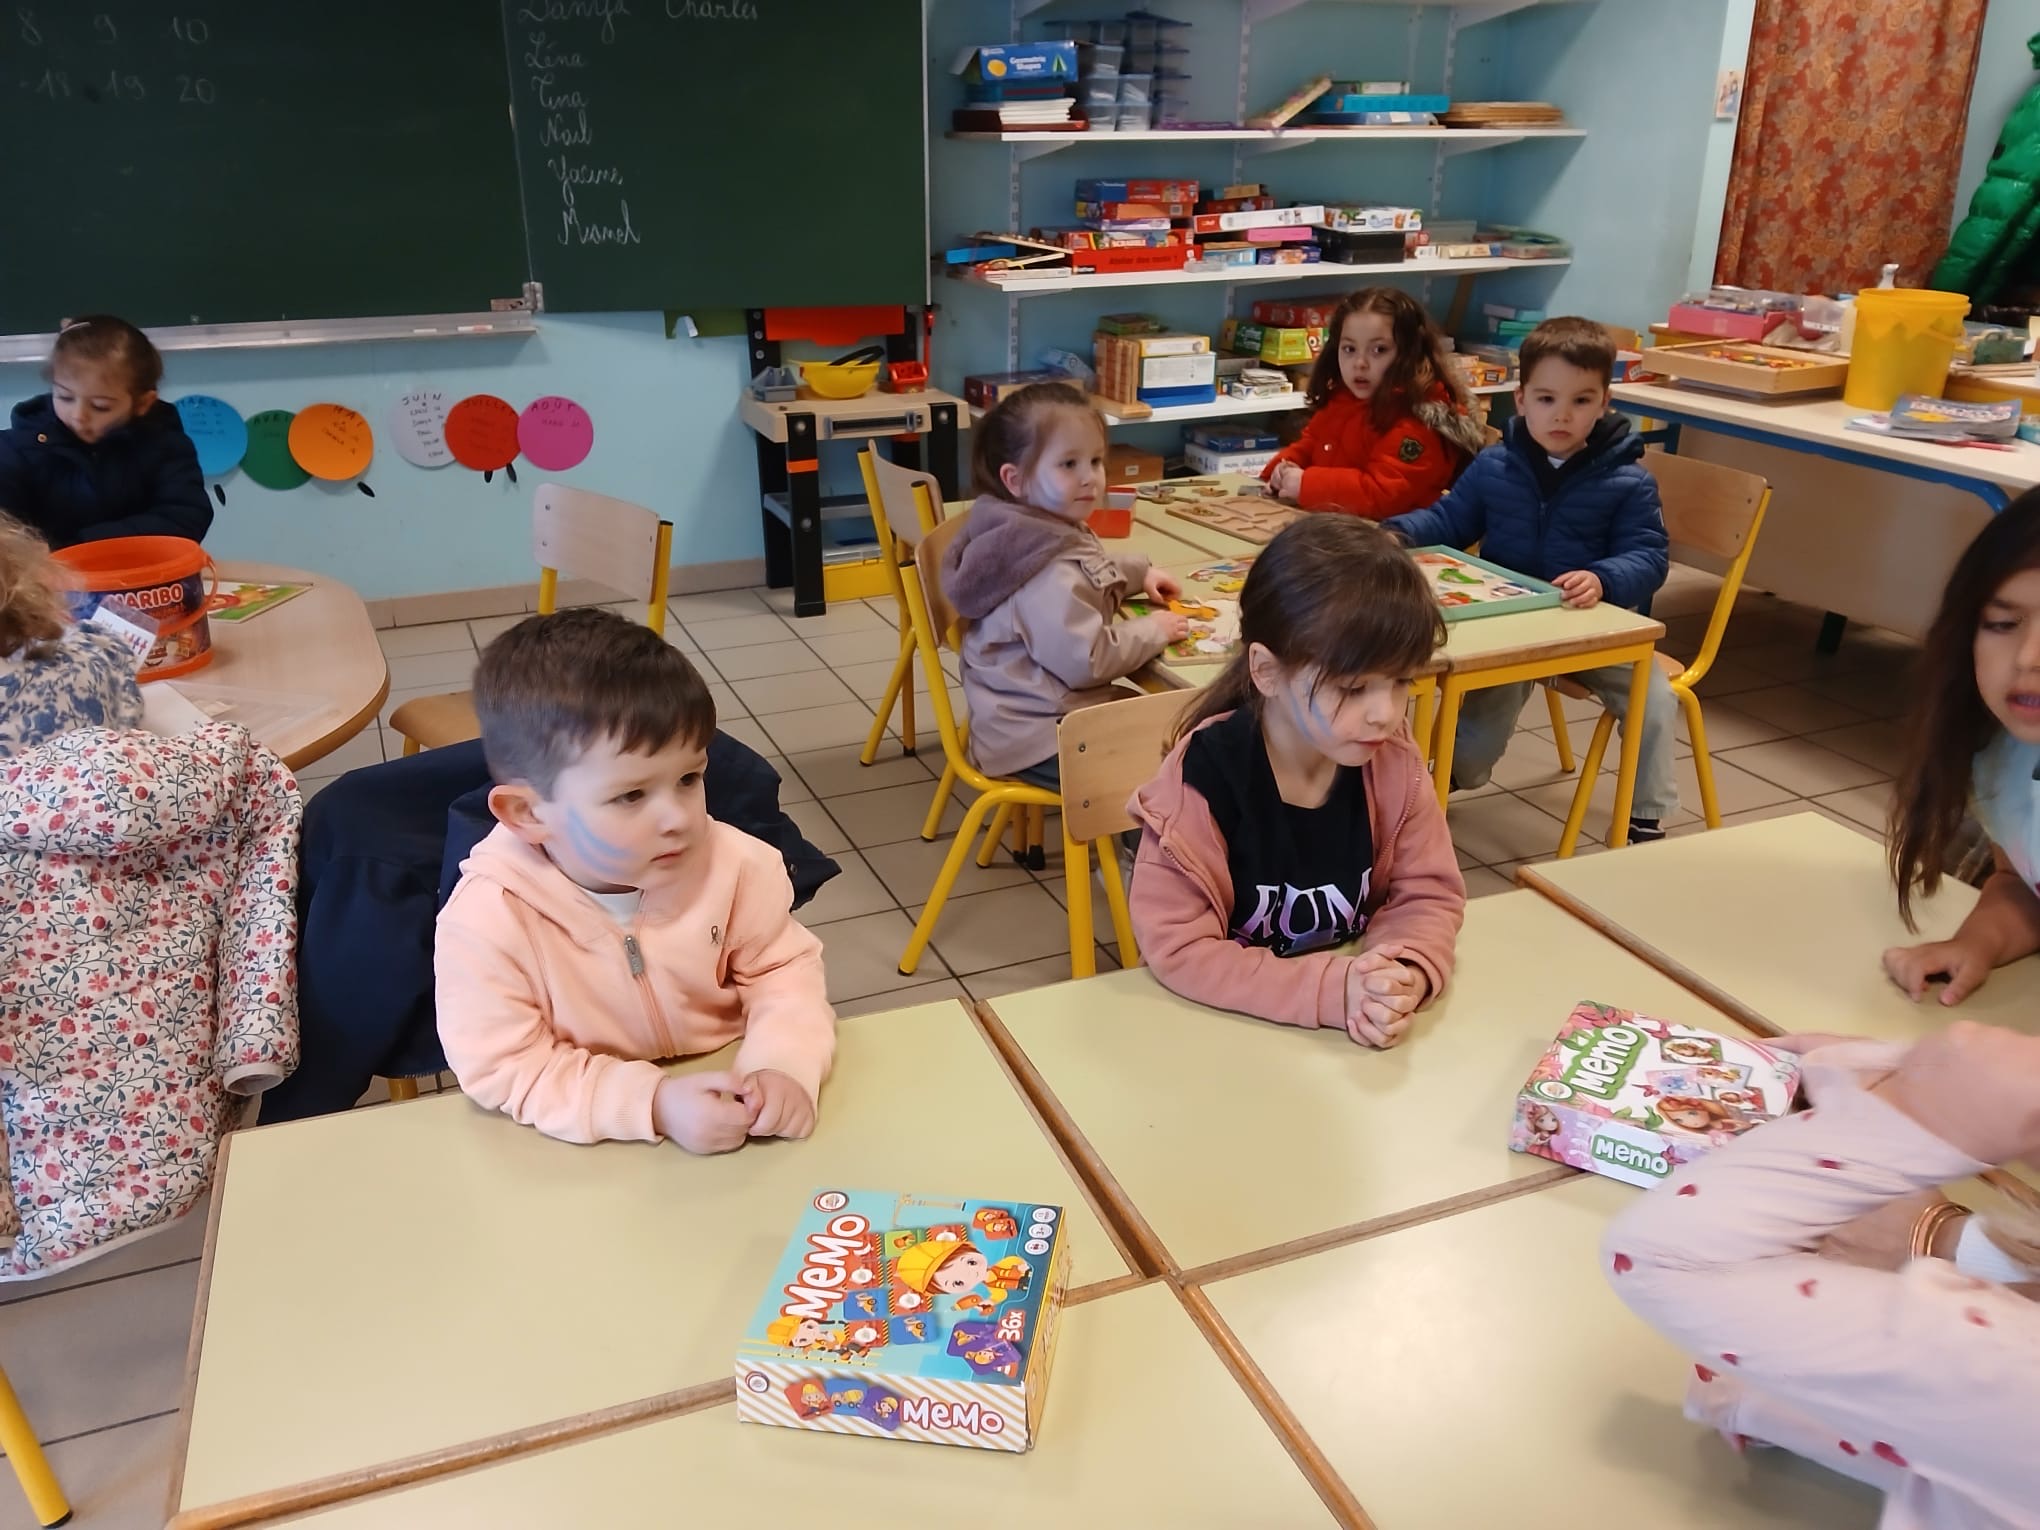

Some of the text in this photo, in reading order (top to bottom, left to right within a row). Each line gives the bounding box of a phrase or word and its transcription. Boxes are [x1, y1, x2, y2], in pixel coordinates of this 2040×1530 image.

[16, 7, 210, 47] 8 9 10
[524, 29, 588, 69] Léna
[105, 69, 147, 101] 19
[175, 73, 217, 105] 20
[401, 392, 442, 407] JUIN
